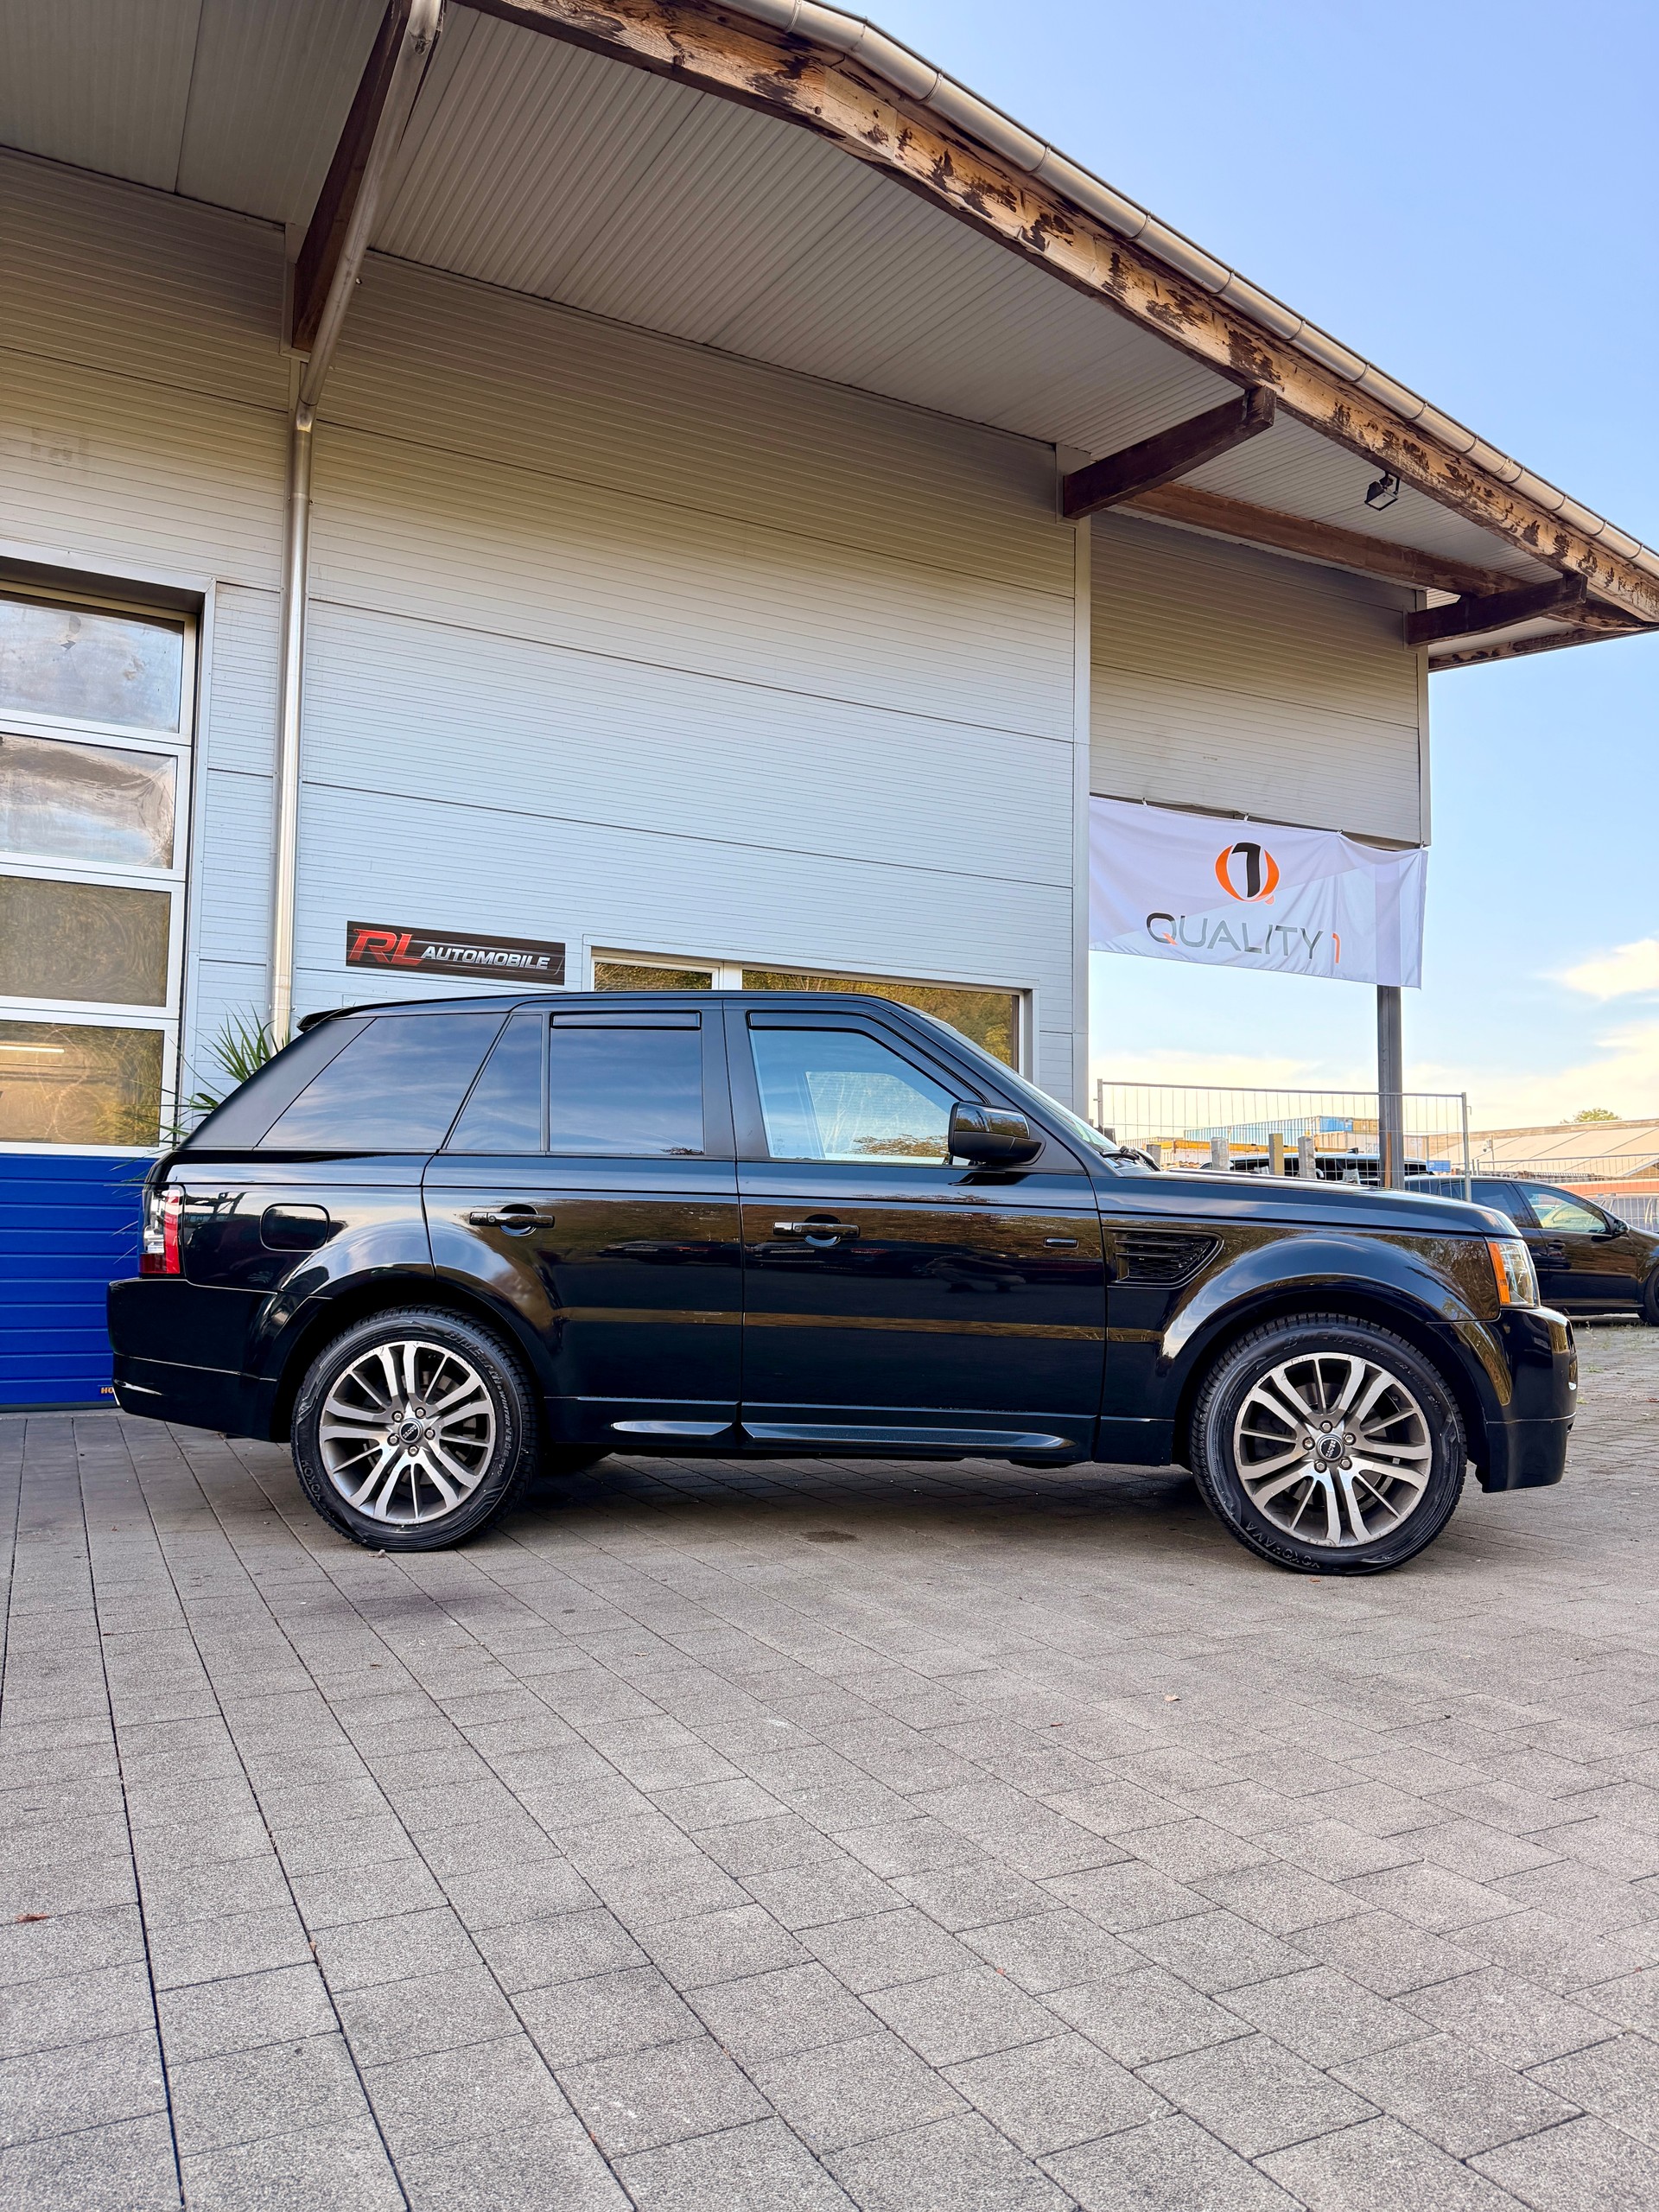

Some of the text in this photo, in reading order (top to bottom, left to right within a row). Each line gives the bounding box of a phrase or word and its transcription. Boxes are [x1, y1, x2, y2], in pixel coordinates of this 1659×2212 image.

[348, 928, 550, 969] RL AUTOMOBILE
[1146, 912, 1324, 960] QUALITY
[1245, 1520, 1320, 1569] YOKOHAMA
